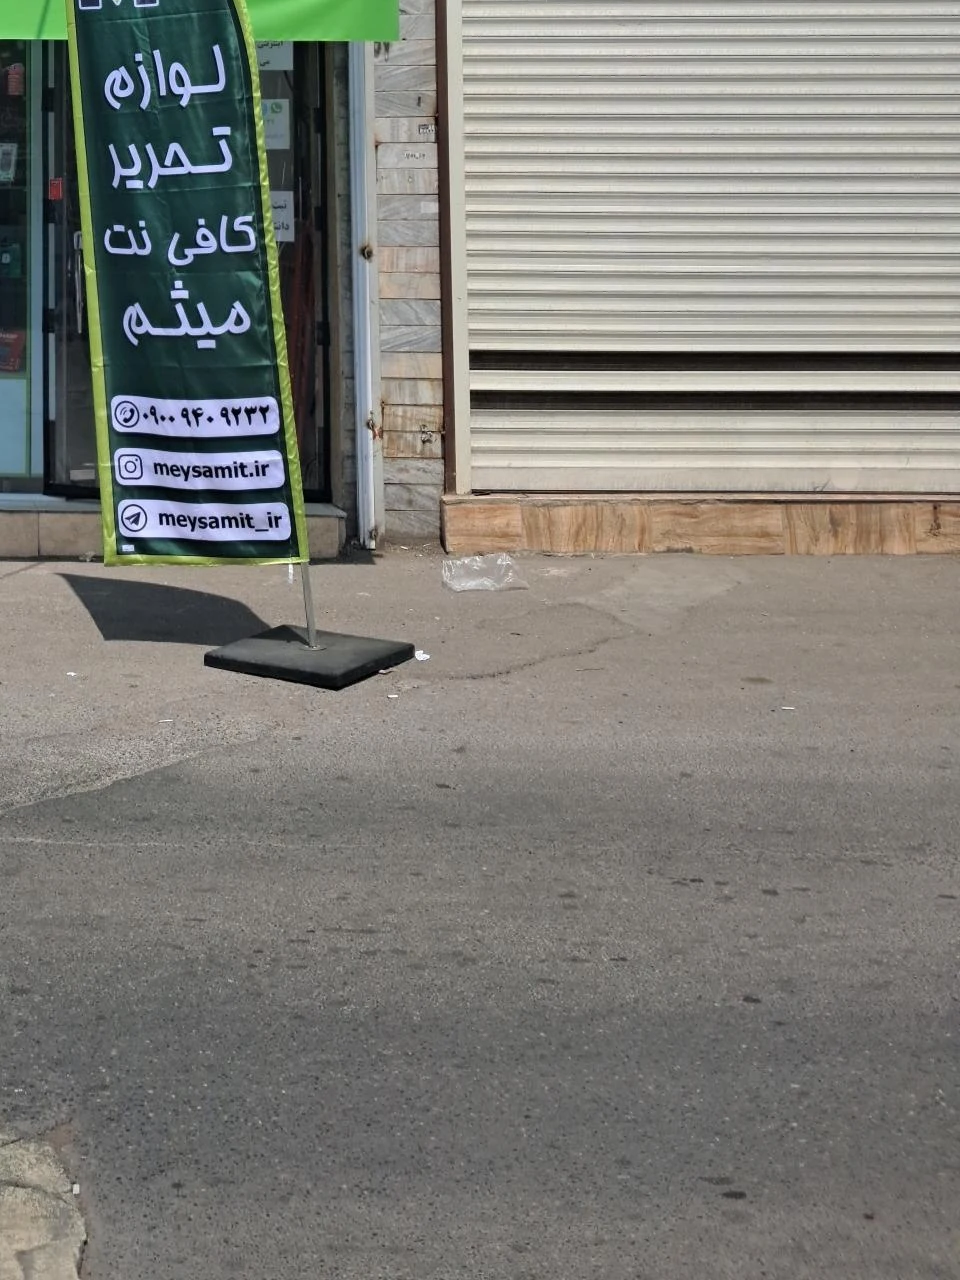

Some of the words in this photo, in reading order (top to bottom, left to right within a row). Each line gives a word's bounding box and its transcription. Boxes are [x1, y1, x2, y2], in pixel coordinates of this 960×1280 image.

[104, 44, 227, 110] لوازم
[108, 126, 233, 189] تحریر
[103, 224, 152, 256] نت
[167, 215, 258, 266] کافی
[122, 280, 252, 349] میثم
[153, 460, 270, 482] meysamit.ir
[158, 511, 283, 533] meysamit_ir
